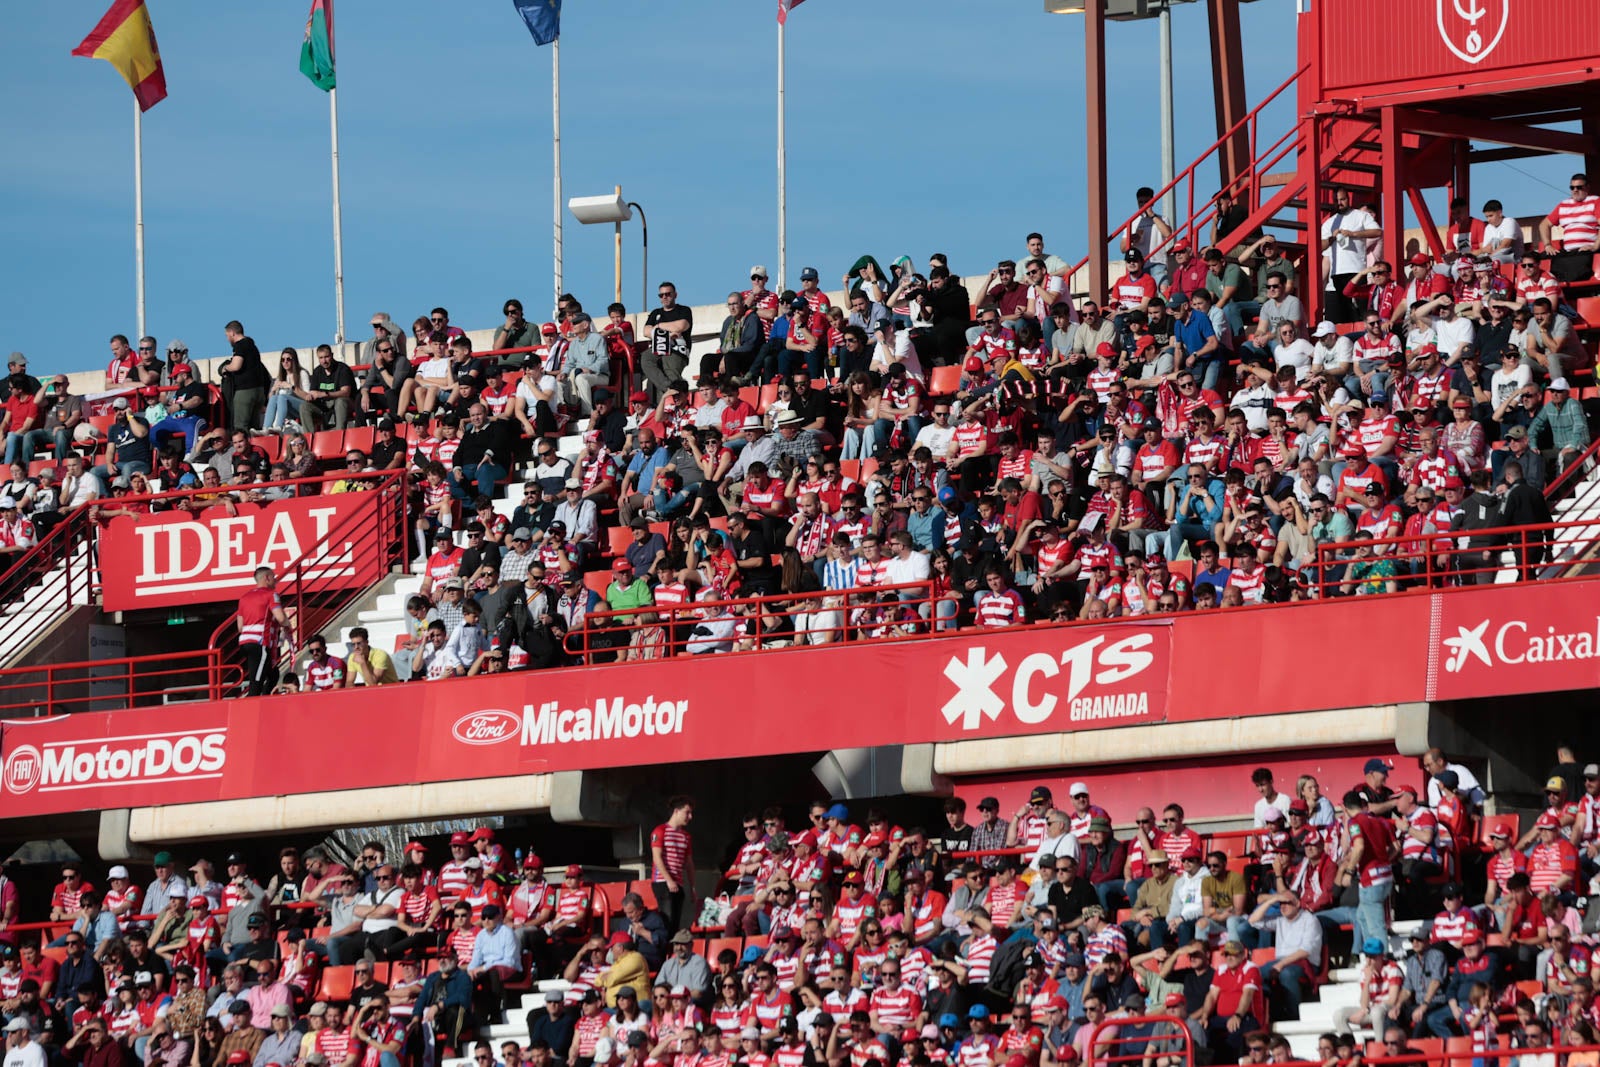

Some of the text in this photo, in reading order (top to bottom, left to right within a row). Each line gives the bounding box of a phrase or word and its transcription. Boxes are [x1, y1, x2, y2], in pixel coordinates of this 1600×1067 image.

[134, 506, 354, 583] IDEAL
[1494, 616, 1600, 665] Caixa
[1011, 633, 1154, 724] CTS
[465, 715, 508, 739] Ford
[520, 695, 689, 746] MicaMotor
[1070, 692, 1149, 721] GRANADA
[13, 758, 34, 782] FIAT
[40, 733, 227, 785] MotorDOS
